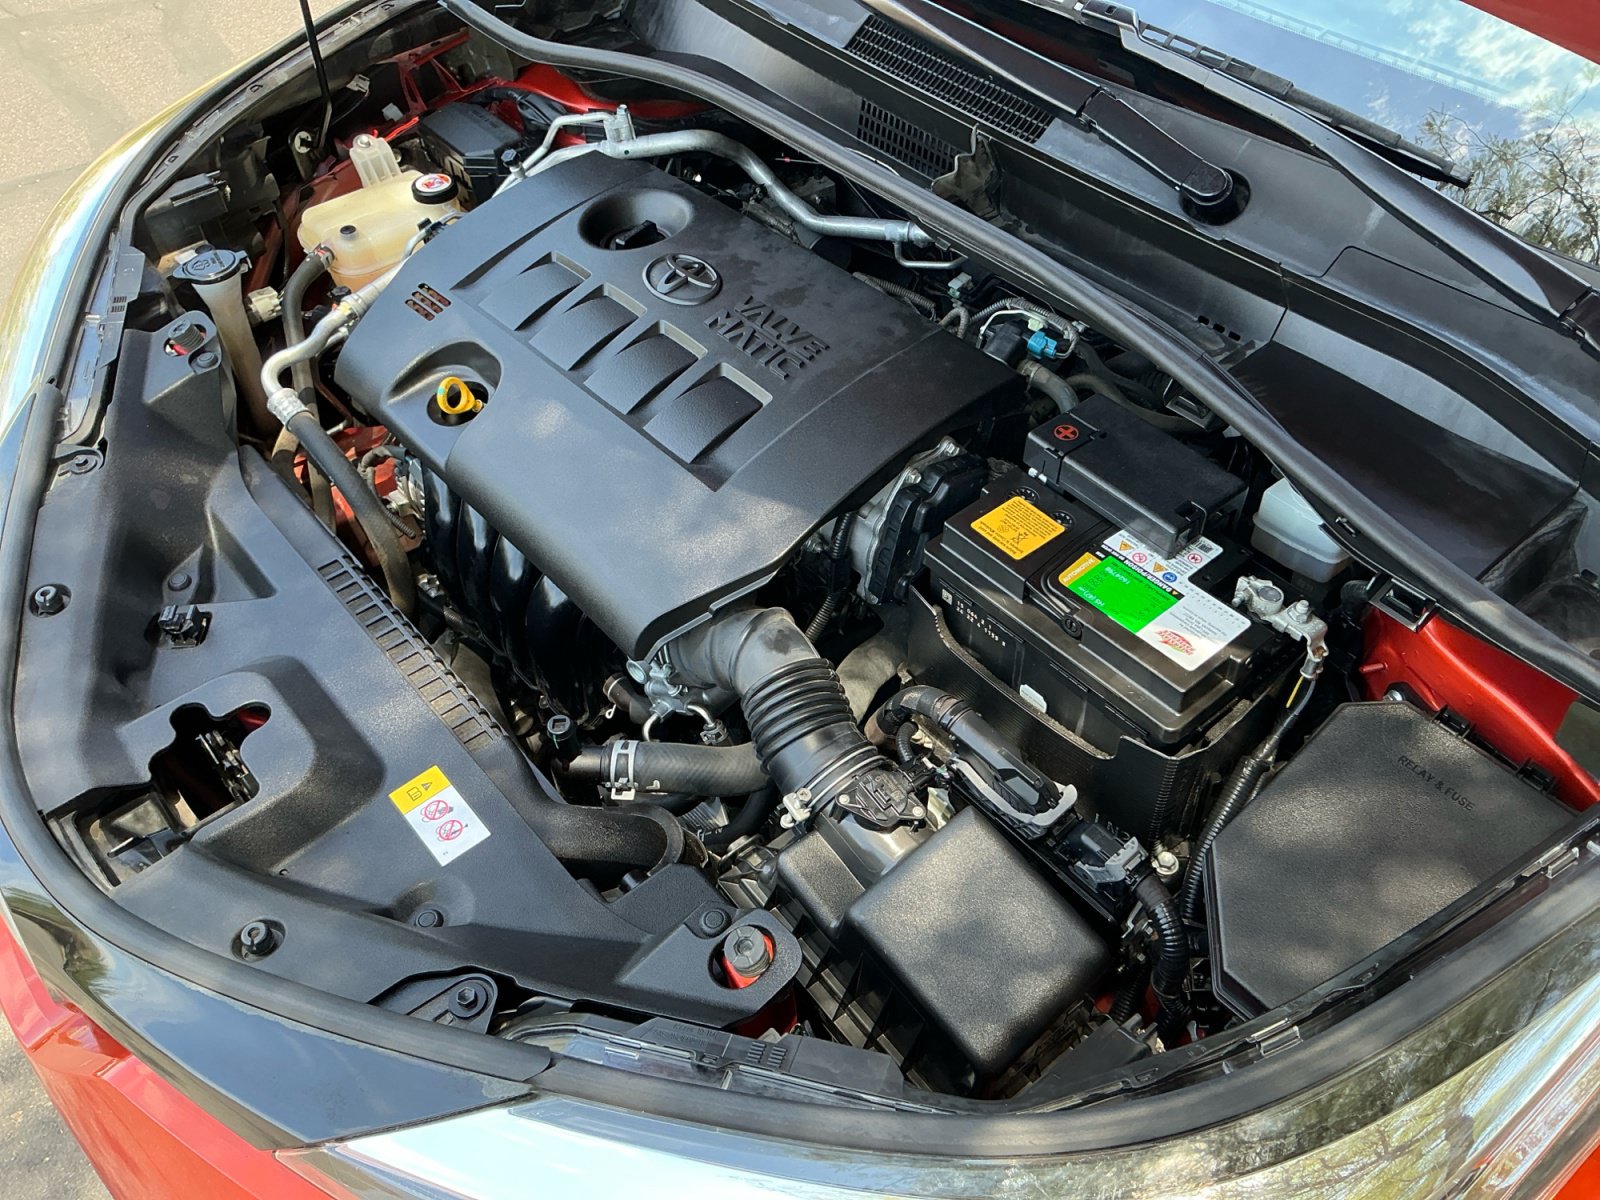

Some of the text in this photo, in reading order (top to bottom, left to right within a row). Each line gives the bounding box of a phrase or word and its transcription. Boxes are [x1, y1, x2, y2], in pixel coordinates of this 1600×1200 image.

[704, 311, 805, 380] MATIC
[735, 296, 830, 361] VALVE
[1123, 558, 1173, 593] DANGER/POISON
[1397, 755, 1476, 811] RELAY & FUSE
